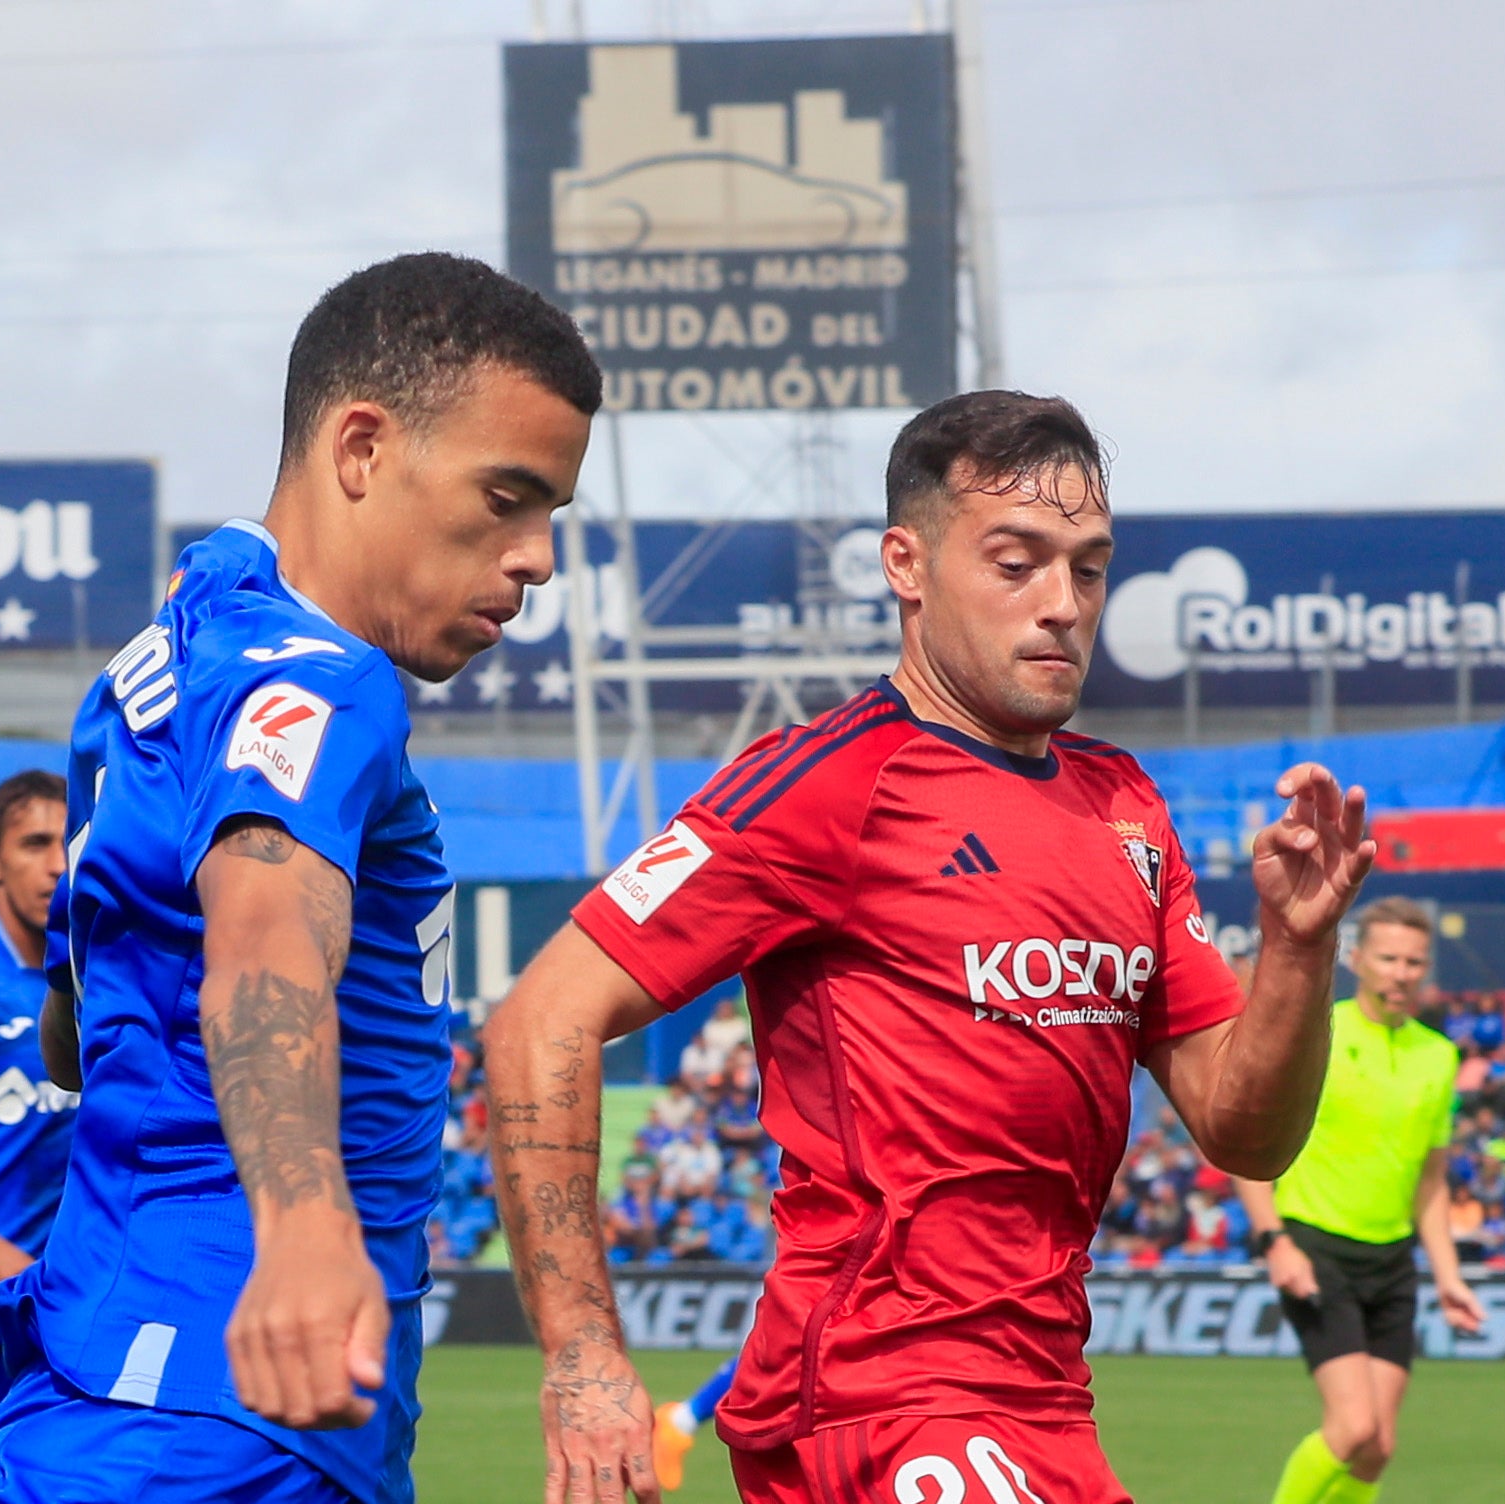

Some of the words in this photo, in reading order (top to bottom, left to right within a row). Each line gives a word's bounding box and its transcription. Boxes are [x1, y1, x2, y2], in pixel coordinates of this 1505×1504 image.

[753, 254, 908, 289] MADRID
[811, 315, 884, 346] DEL
[601, 355, 912, 411] UTOMÓVIL
[238, 741, 295, 780] LALIGA
